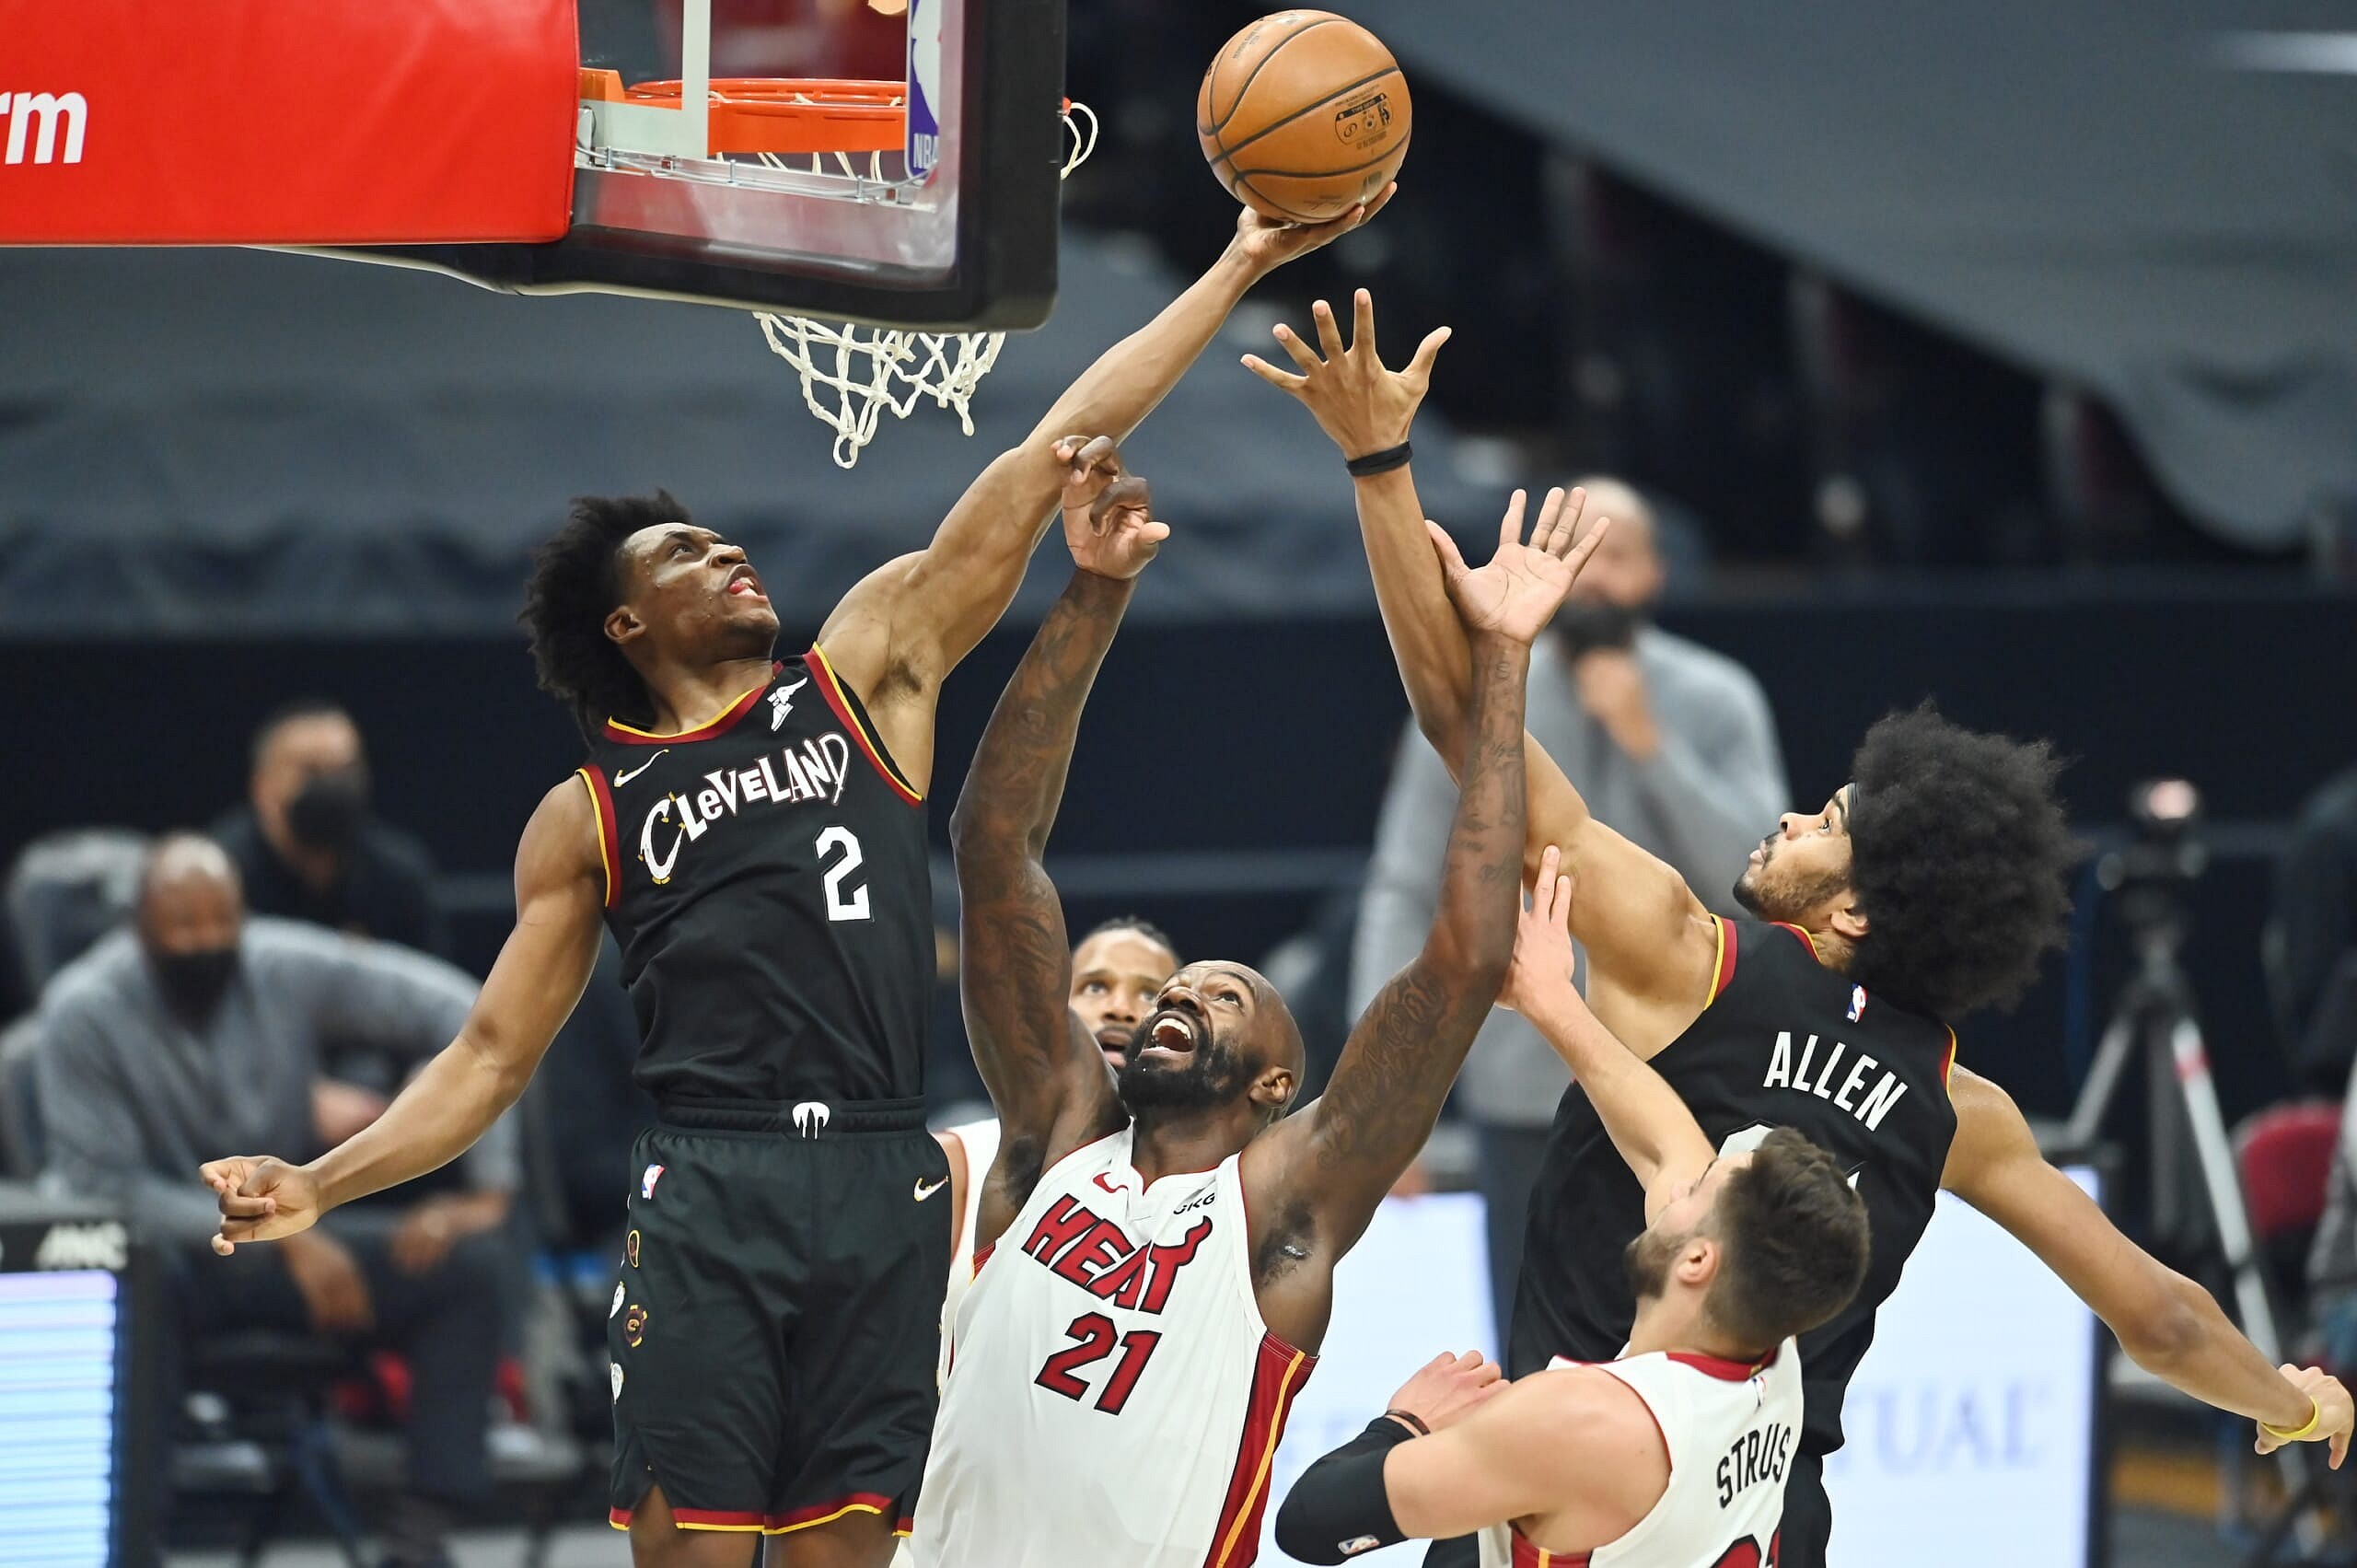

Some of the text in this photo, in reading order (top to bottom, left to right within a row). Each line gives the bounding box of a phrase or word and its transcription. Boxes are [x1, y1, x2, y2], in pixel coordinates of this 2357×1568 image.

[814, 826, 874, 922] 2
[1762, 1030, 1909, 1132] ALLEN
[1021, 1192, 1213, 1315] HEAT
[1034, 1311, 1163, 1415] 21
[1716, 1423, 1791, 1510] STRUS
